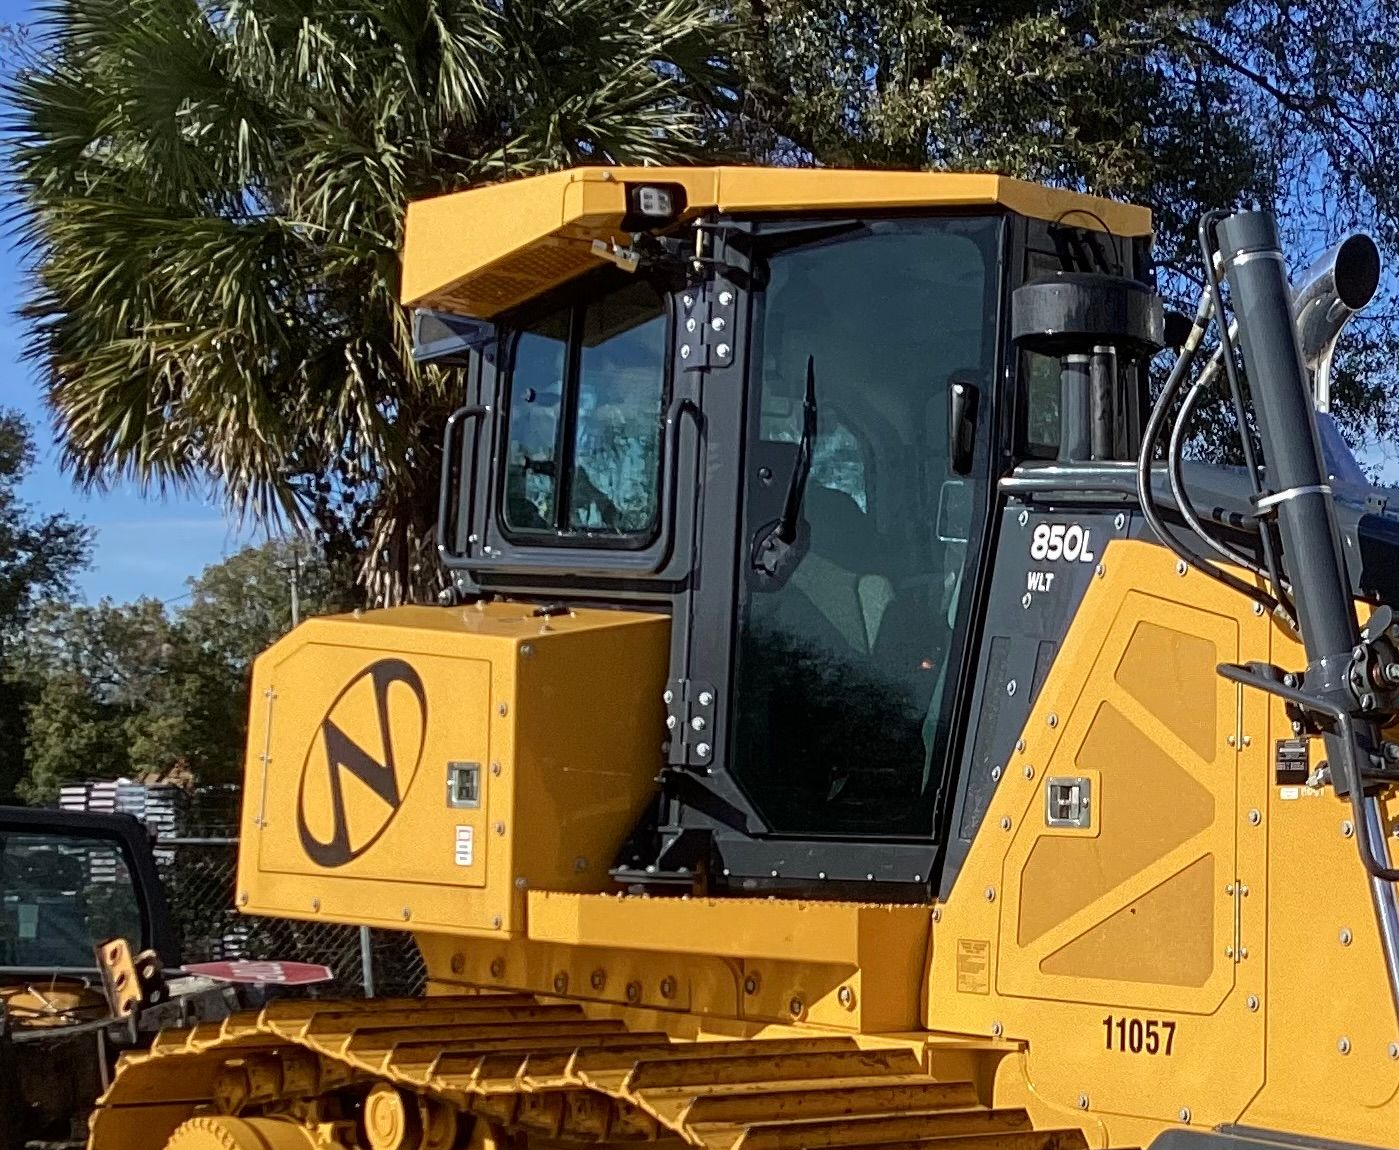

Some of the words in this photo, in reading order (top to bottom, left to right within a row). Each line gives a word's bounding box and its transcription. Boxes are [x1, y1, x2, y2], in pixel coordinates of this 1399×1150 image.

[1031, 523, 1094, 562] 850L
[1027, 571, 1054, 592] WLT
[1102, 1014, 1176, 1056] 11057
